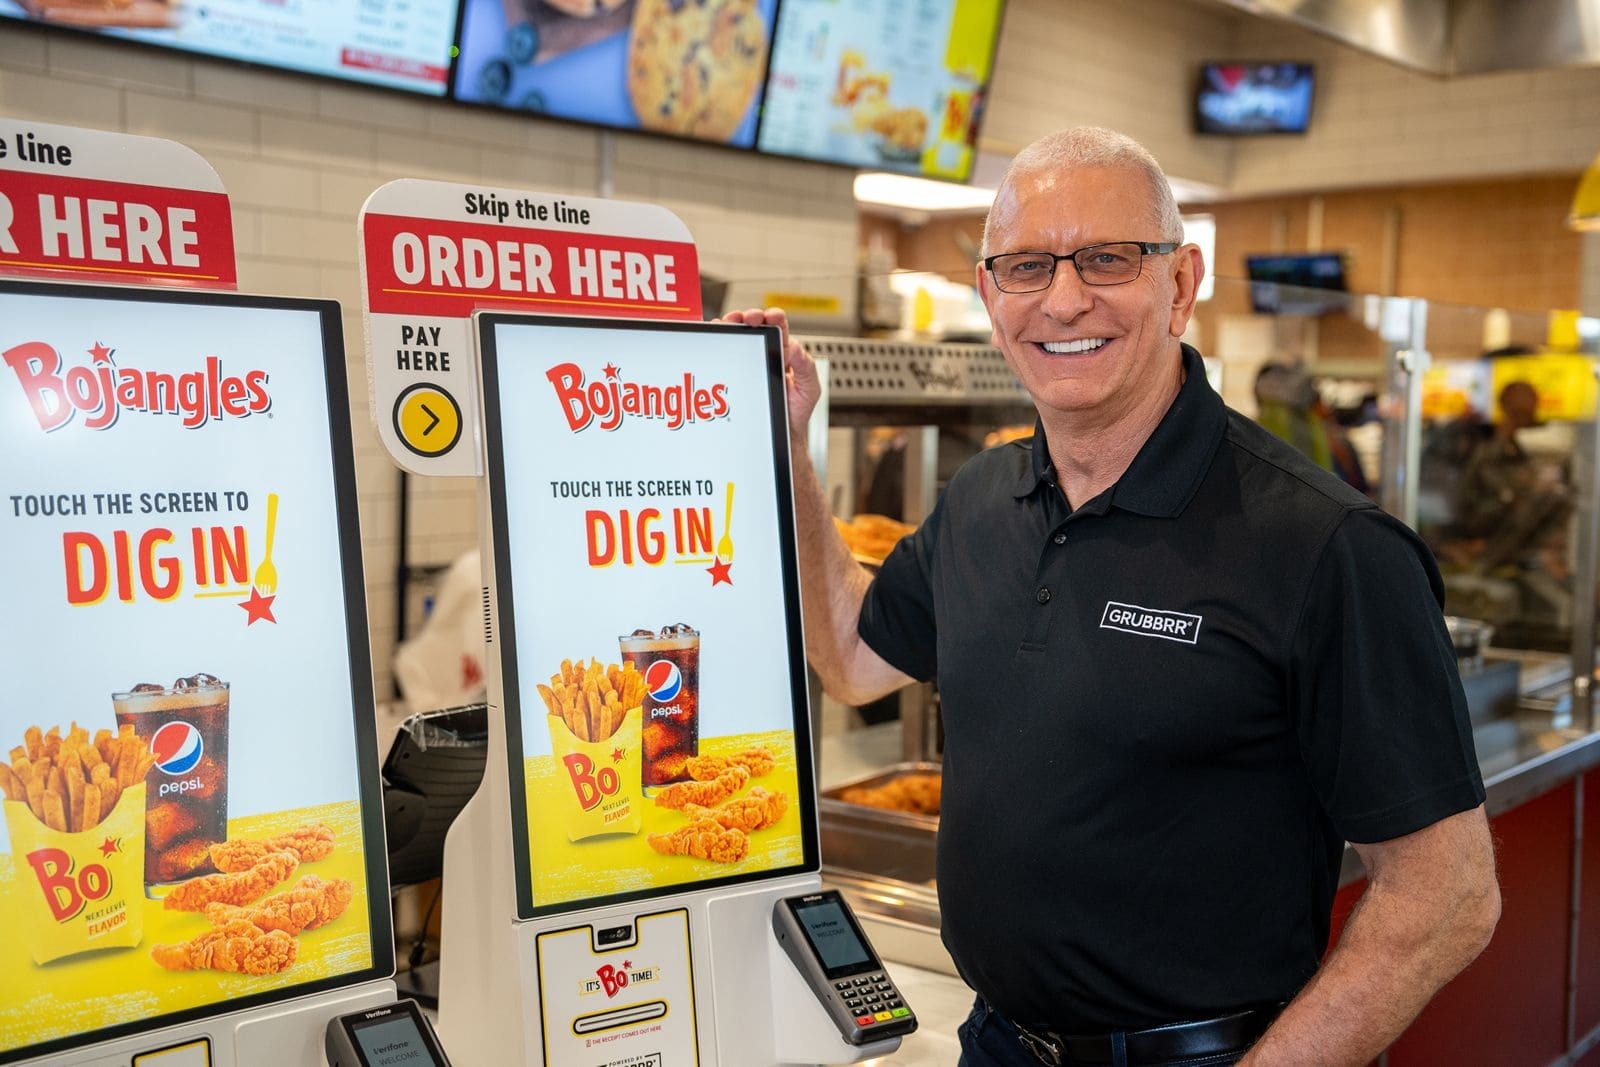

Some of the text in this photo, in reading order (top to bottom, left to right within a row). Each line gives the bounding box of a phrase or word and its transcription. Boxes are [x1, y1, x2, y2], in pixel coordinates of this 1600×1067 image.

[16, 133, 72, 166] line
[465, 193, 590, 225] Skip the line
[38, 194, 200, 267] HERE
[392, 232, 677, 303] ORDER HERE
[402, 326, 441, 346] PAY
[397, 350, 450, 371] HERE
[551, 480, 713, 498] TOUCH THE SCREEN TO
[10, 491, 249, 516] TOUCH THE SCREEN TO
[585, 507, 666, 568] DIG
[62, 527, 183, 607] DIG
[652, 704, 680, 719] pepsi
[159, 776, 202, 797] pepsi
[562, 753, 621, 812] Bo
[604, 806, 630, 823] FLAVOR
[27, 847, 113, 924] Bo
[106, 899, 126, 914] LEVEL
[88, 912, 126, 936] FLAVOR
[586, 964, 652, 999] IT'S Bo TIME!
[365, 1009, 392, 1019] Verifone
[373, 1041, 409, 1055] Verifone
[379, 1050, 420, 1066] WELCOME
